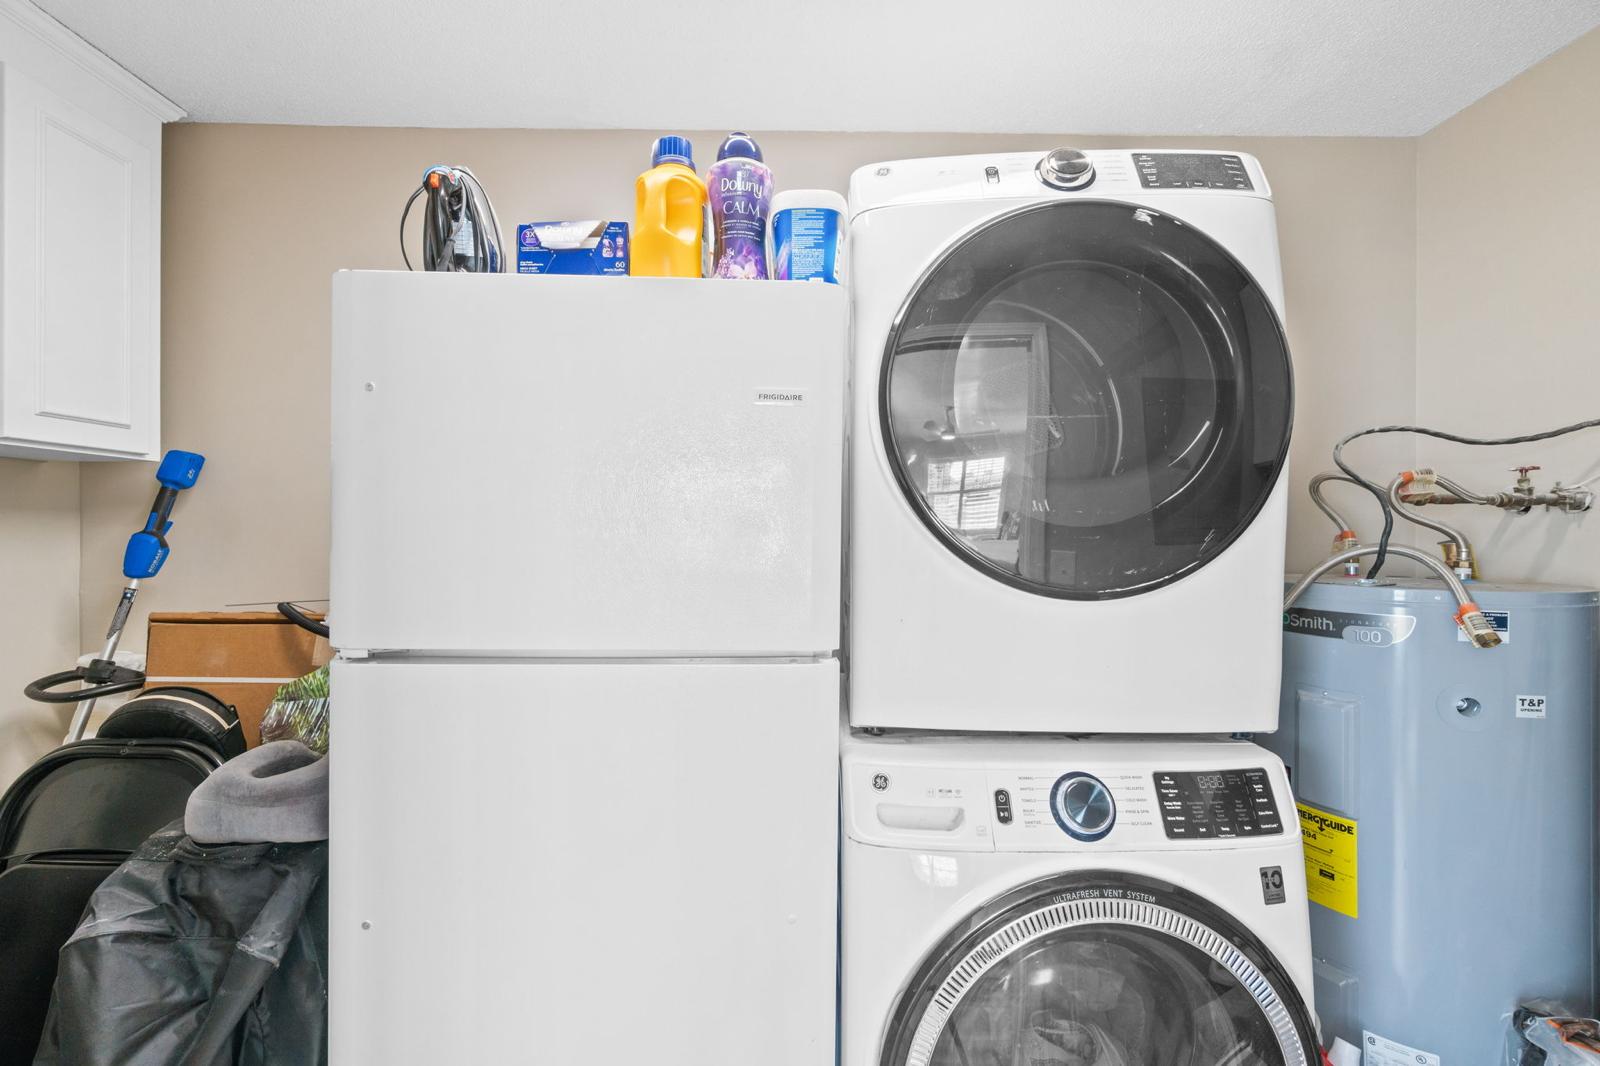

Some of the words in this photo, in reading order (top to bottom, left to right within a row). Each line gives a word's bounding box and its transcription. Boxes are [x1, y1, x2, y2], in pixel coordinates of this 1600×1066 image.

[721, 177, 763, 199] Downy
[723, 200, 761, 217] CALM
[525, 231, 536, 239] 3X
[758, 393, 803, 401] FRIGIDAIRE
[1354, 629, 1382, 644] 100
[1519, 698, 1545, 707] T&P
[1261, 870, 1283, 889] 10
[1053, 889, 1100, 904] ULTRAFRESH
[1103, 888, 1123, 898] VENT
[1127, 890, 1156, 903] SYSTEM
